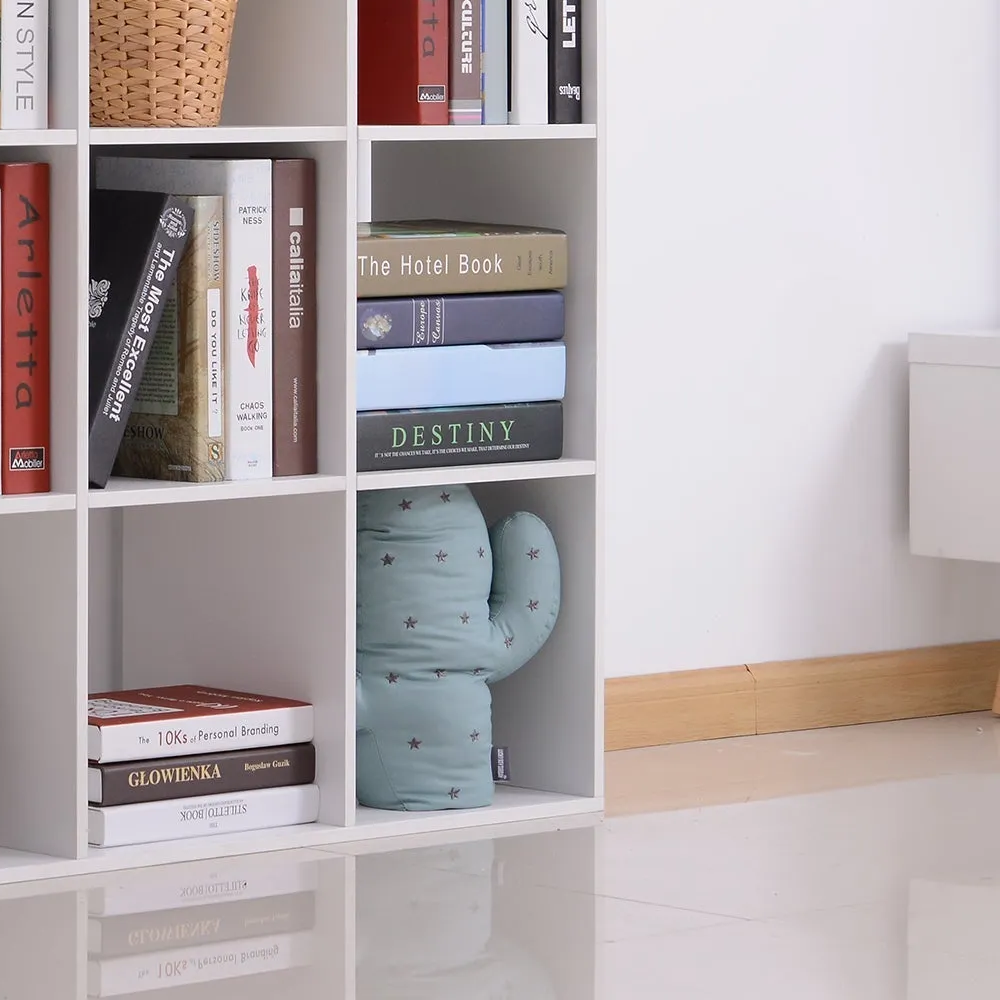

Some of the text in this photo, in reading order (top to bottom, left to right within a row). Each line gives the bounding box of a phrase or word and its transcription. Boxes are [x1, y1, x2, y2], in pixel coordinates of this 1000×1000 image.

[461, 0, 472, 74] CULTURE
[562, 0, 577, 48] LET
[16, 27, 35, 111] STYLE
[238, 206, 267, 214] PATRICK
[242, 217, 263, 225] NESS
[154, 242, 163, 258] and
[358, 255, 391, 276] The
[400, 254, 449, 275] Hotel
[459, 253, 503, 274] Book
[155, 249, 176, 281] The
[139, 259, 159, 305] Lamentable
[289, 231, 304, 329] caliaitalia
[15, 194, 42, 410] Arletta
[138, 285, 163, 332] Most
[127, 306, 144, 338] Tragedy
[211, 310, 217, 327] DO
[416, 300, 427, 344] Europe
[432, 299, 441, 343] Canvas
[115, 347, 130, 376] Romeo
[109, 335, 147, 422] Excellent
[110, 377, 119, 393] and
[103, 393, 114, 415] Juliet
[211, 393, 218, 404] IT
[240, 402, 265, 410] CHAOS
[236, 412, 268, 421] WALKING
[391, 420, 516, 448] DESTINY
[138, 724, 279, 746] The 10Ks of Personal Branding
